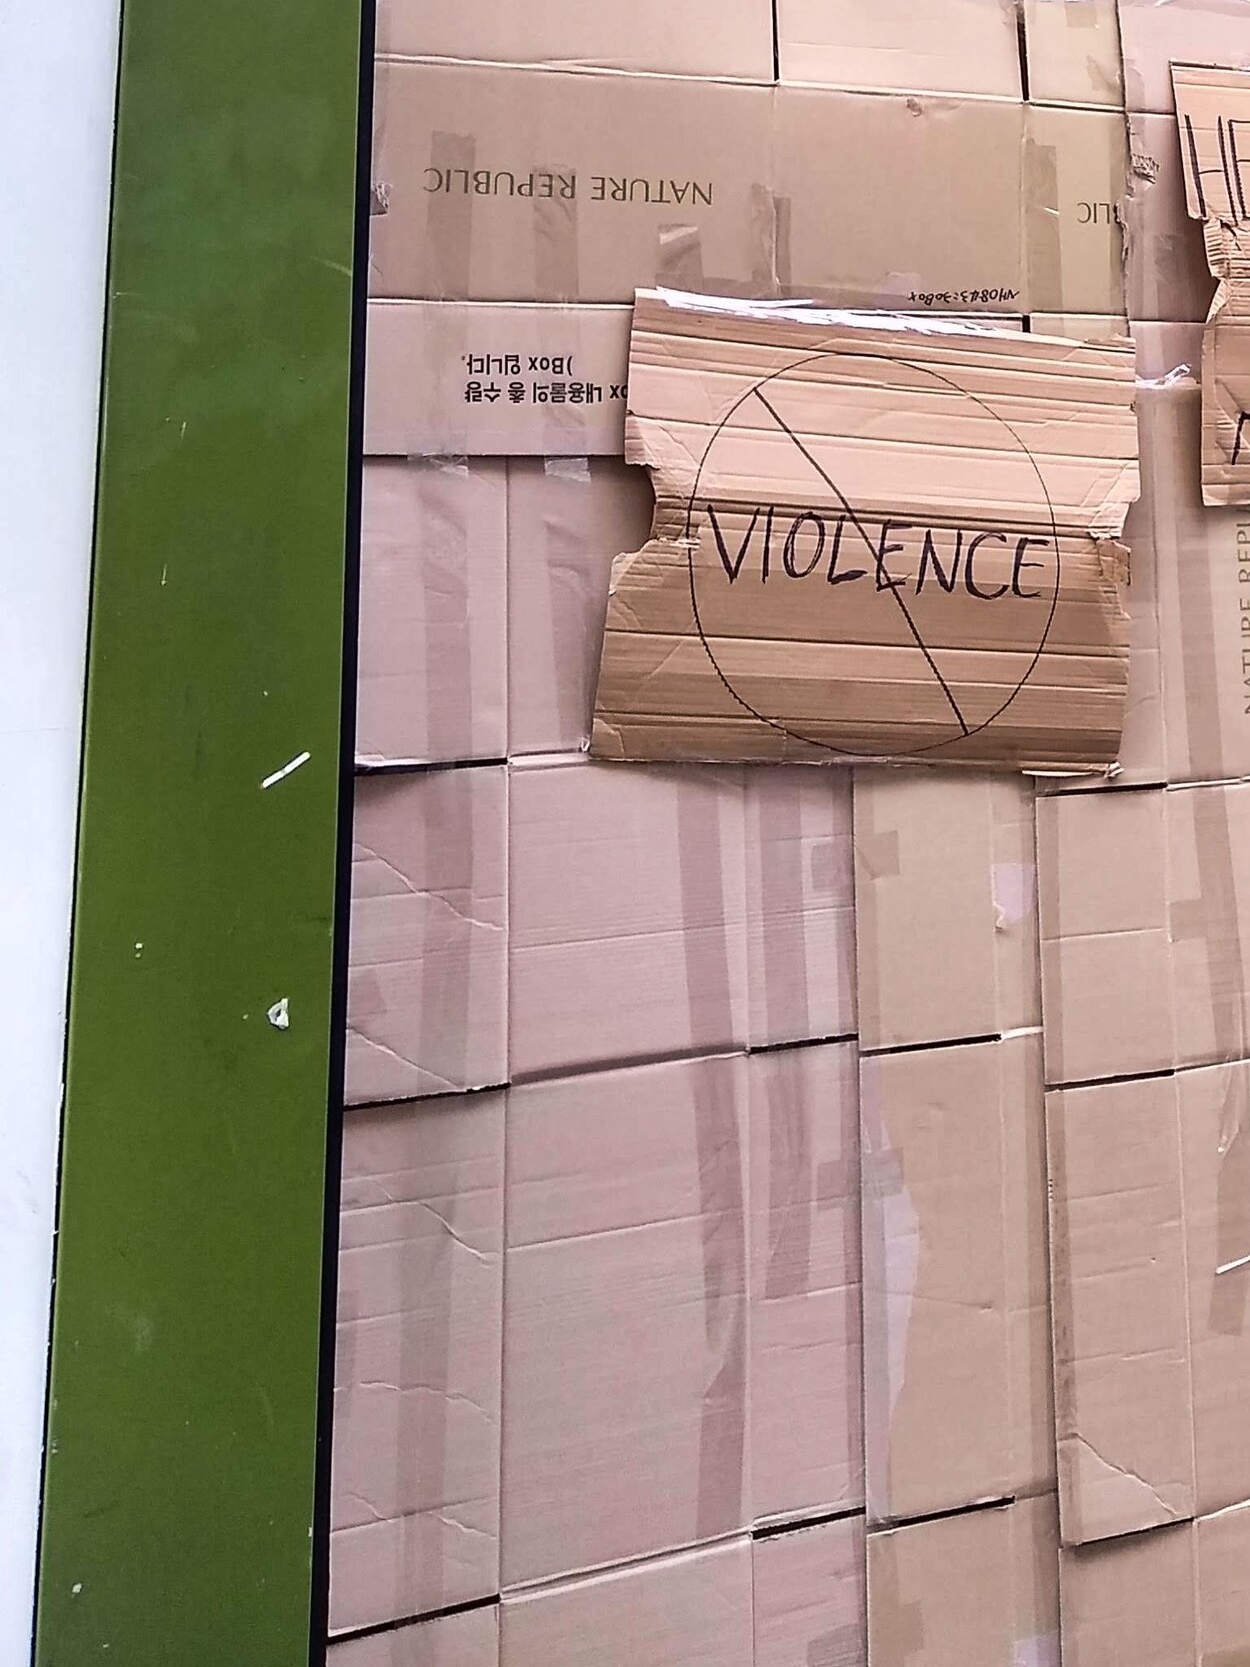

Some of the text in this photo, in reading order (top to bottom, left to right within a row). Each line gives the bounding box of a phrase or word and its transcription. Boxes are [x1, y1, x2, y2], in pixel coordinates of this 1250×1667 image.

[423, 167, 713, 206] NATURE REPUBLIC
[464, 381, 502, 403] 수량
[508, 383, 526, 404] 총
[532, 382, 603, 404] 내용물의
[705, 504, 1051, 600] VIOLENCE
